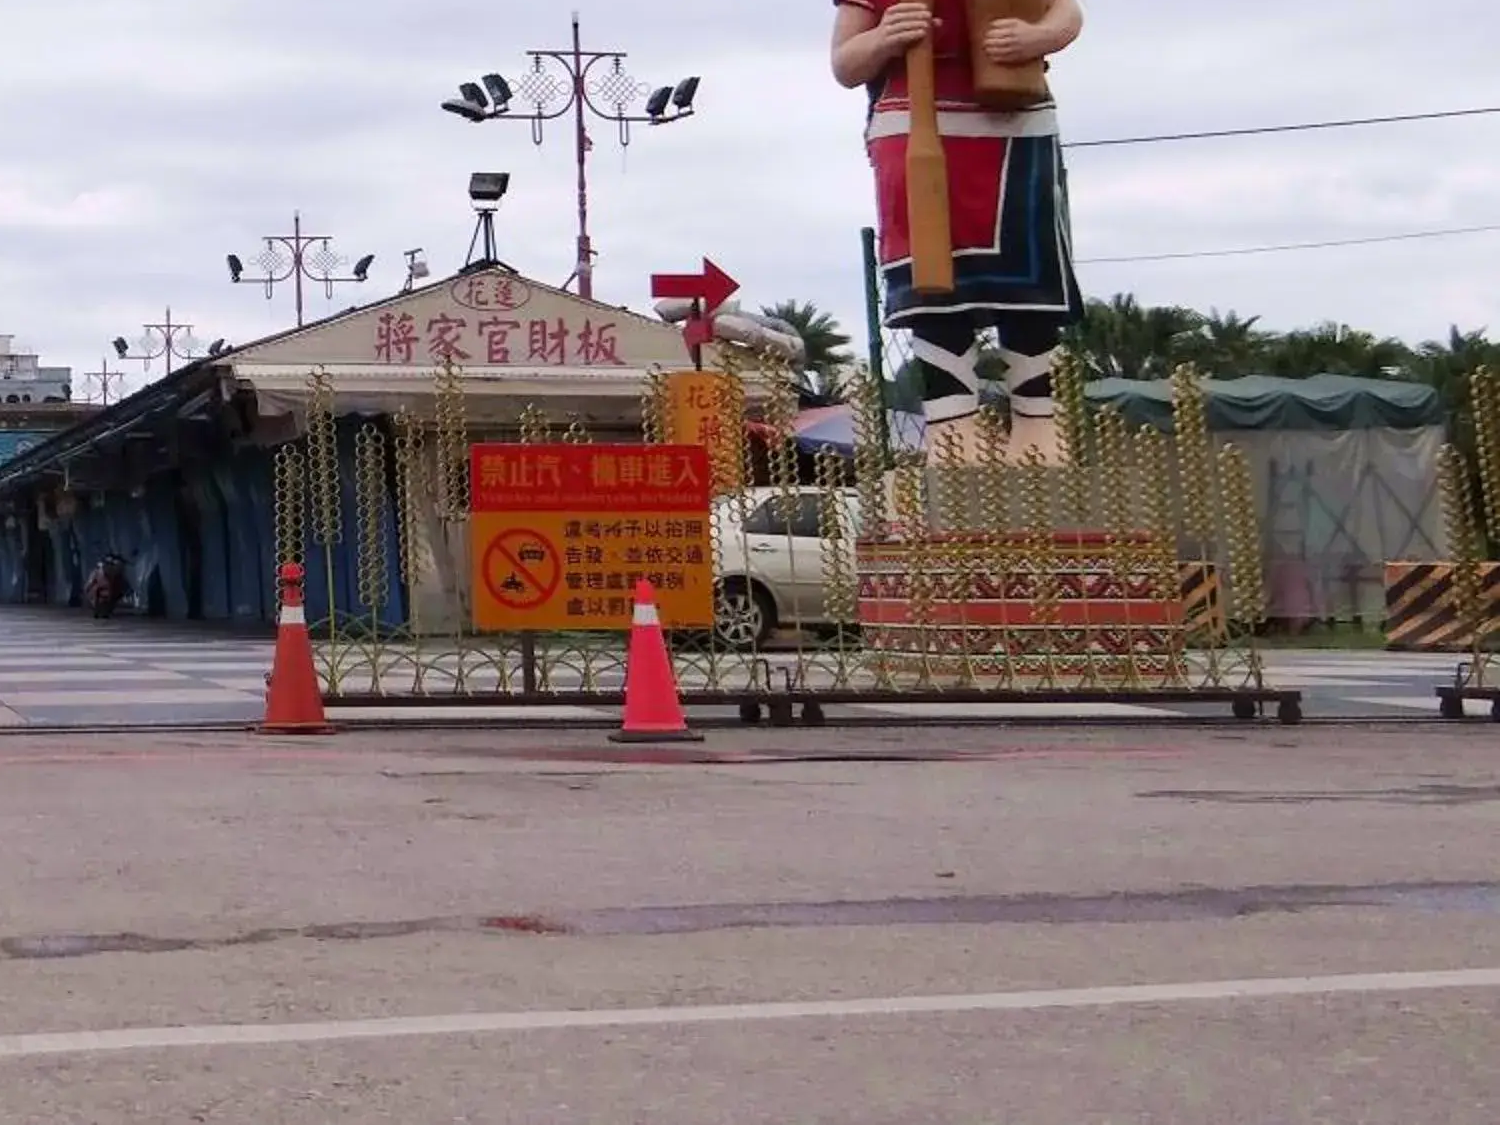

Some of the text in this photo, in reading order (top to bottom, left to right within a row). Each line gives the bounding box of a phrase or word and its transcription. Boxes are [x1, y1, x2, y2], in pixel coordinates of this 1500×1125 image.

[464, 278, 517, 307] 花蓮
[374, 311, 627, 366] 蔣家官財板
